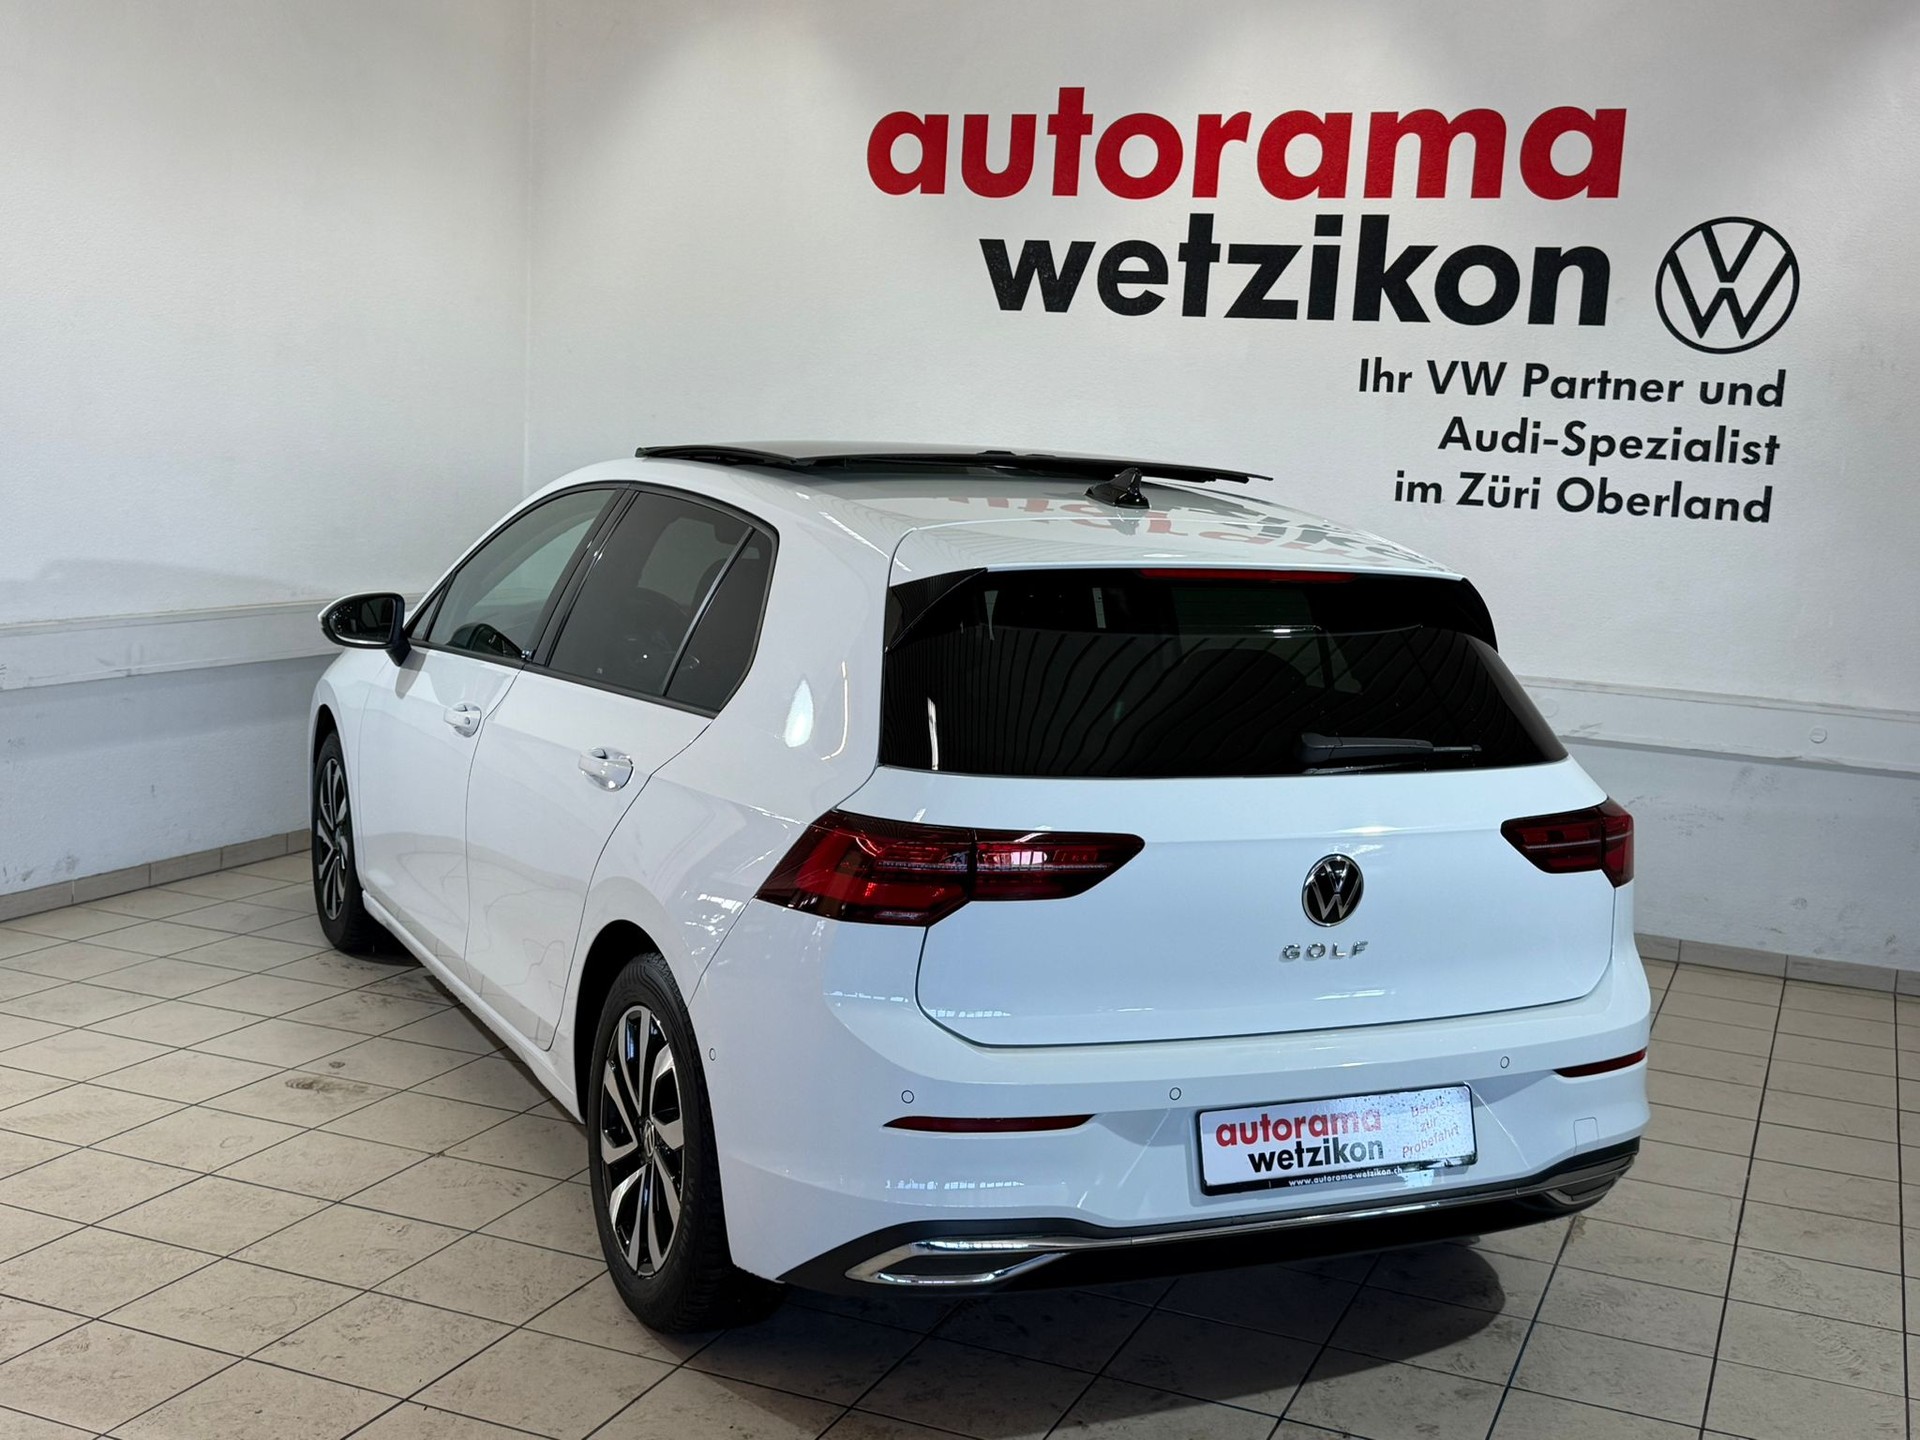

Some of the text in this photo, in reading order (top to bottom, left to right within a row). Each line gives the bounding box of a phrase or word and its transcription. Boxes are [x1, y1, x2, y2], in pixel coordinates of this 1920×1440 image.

[866, 86, 1628, 201] autorama
[978, 212, 1611, 327] wetzikon
[1359, 356, 1787, 408] Ihr VW Partner und
[1437, 416, 1781, 467] Audi-Spezialist
[1394, 470, 1773, 524] im Züri Oberland
[1281, 940, 1369, 960] GOLF
[1215, 1108, 1382, 1148] autorama
[1247, 1136, 1385, 1173] wetzikon
[1288, 1165, 1404, 1187] www.autorama-wetzikon.ch
